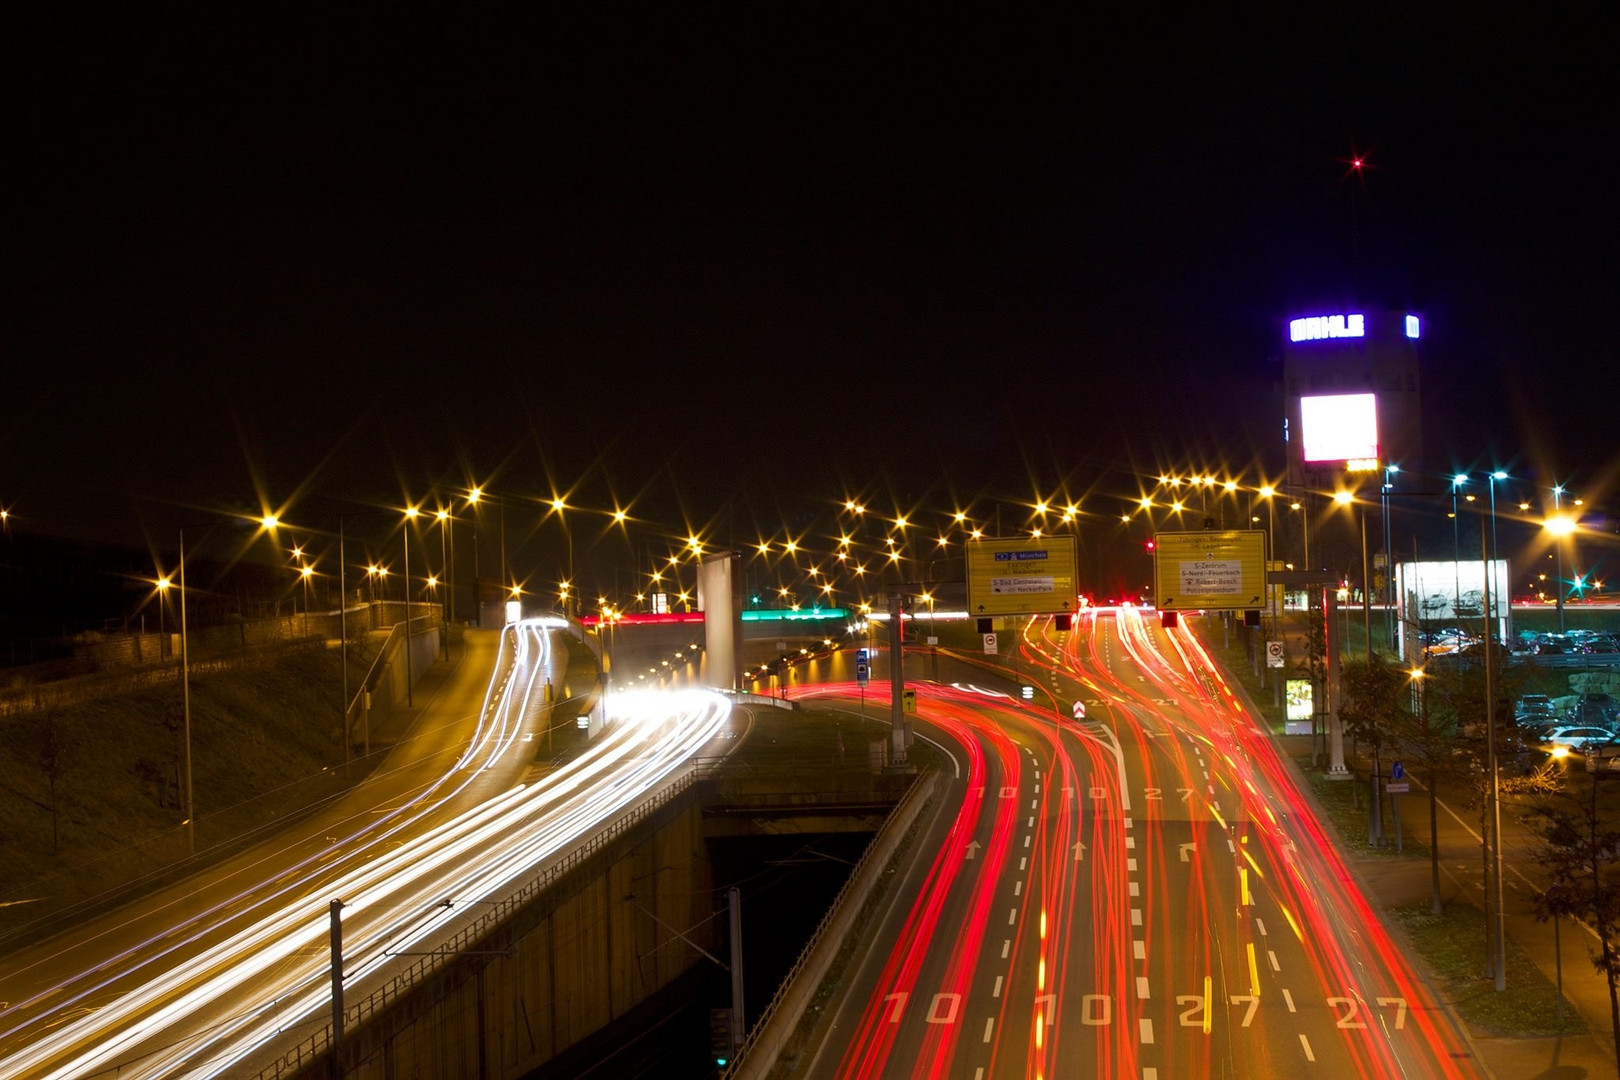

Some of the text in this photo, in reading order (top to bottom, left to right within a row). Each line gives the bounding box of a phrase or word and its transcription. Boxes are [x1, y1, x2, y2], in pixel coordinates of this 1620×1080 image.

[1290, 314, 1365, 342] MAHLE
[1144, 788, 1194, 801] 27
[884, 992, 961, 1024] 10
[1035, 994, 1111, 1025] 10
[1176, 995, 1260, 1027] 27
[1326, 997, 1407, 1029] 27
